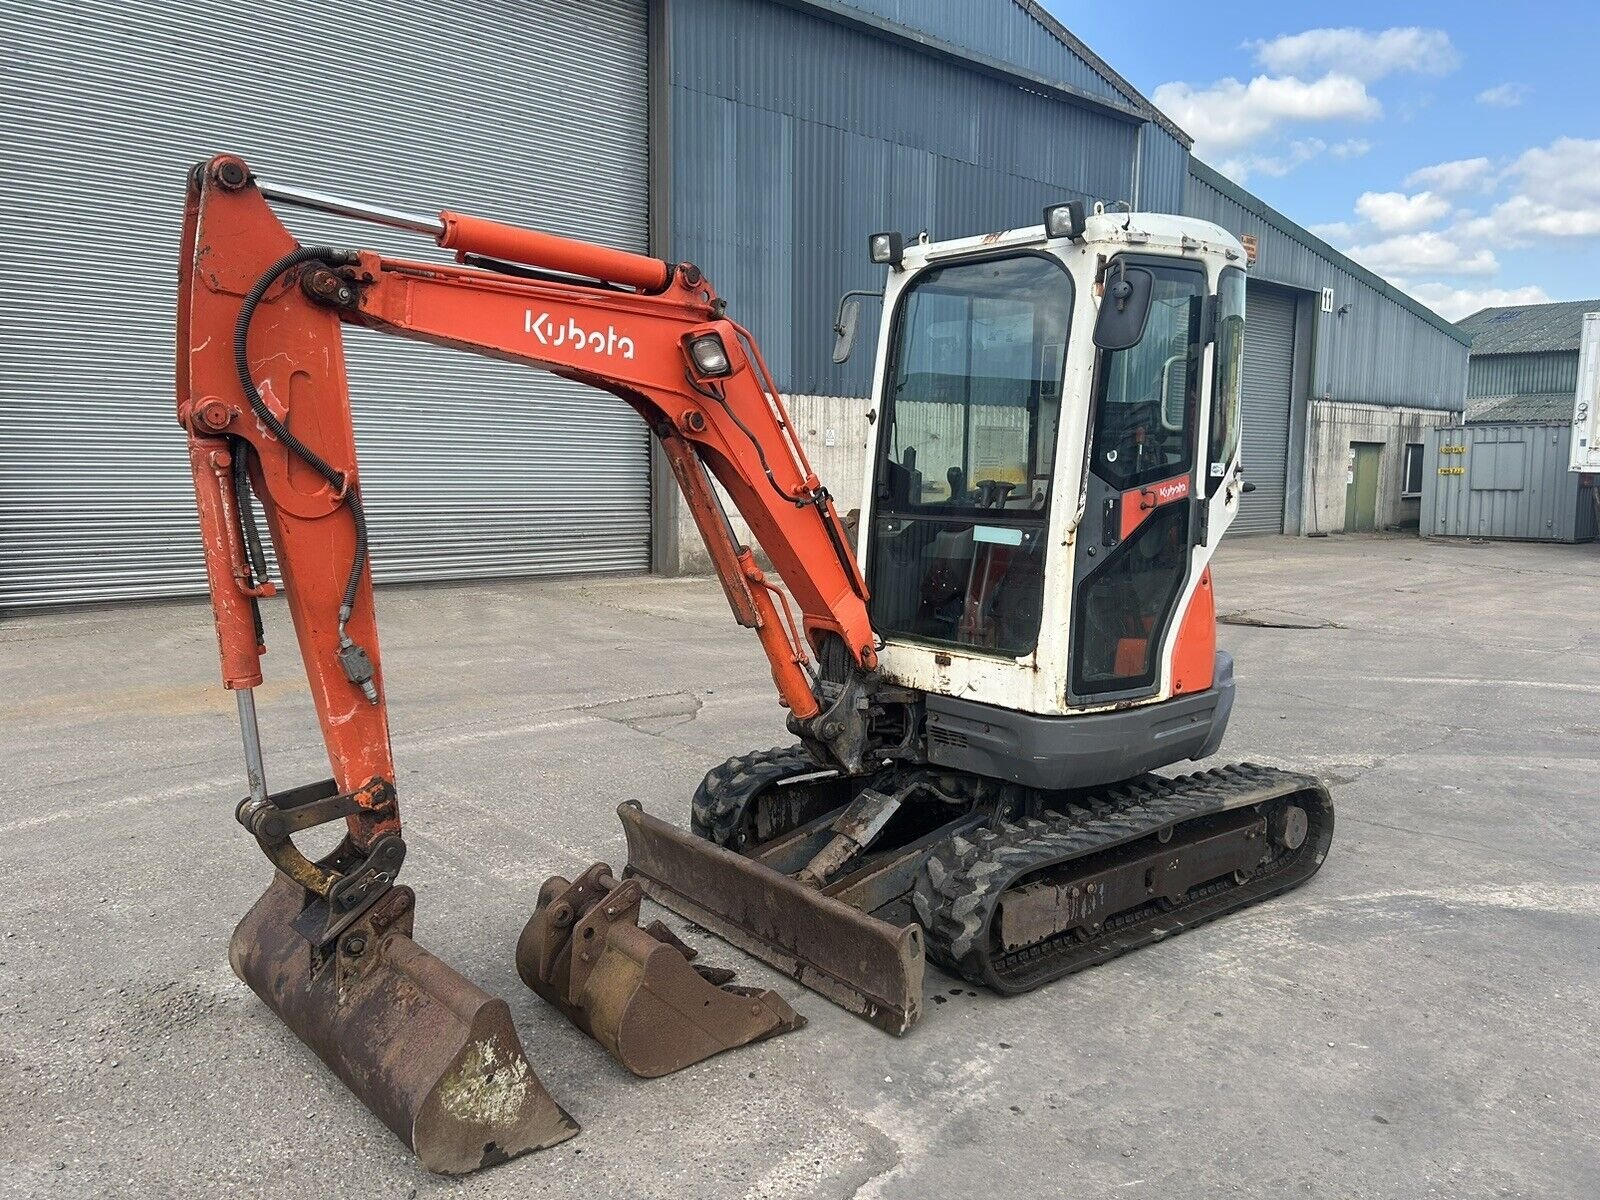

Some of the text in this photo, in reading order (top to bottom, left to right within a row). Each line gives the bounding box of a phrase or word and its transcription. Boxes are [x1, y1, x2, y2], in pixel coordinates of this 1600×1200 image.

[1323, 289, 1332, 310] 11
[524, 308, 635, 360] Kubota
[1159, 482, 1186, 498] Kubota
